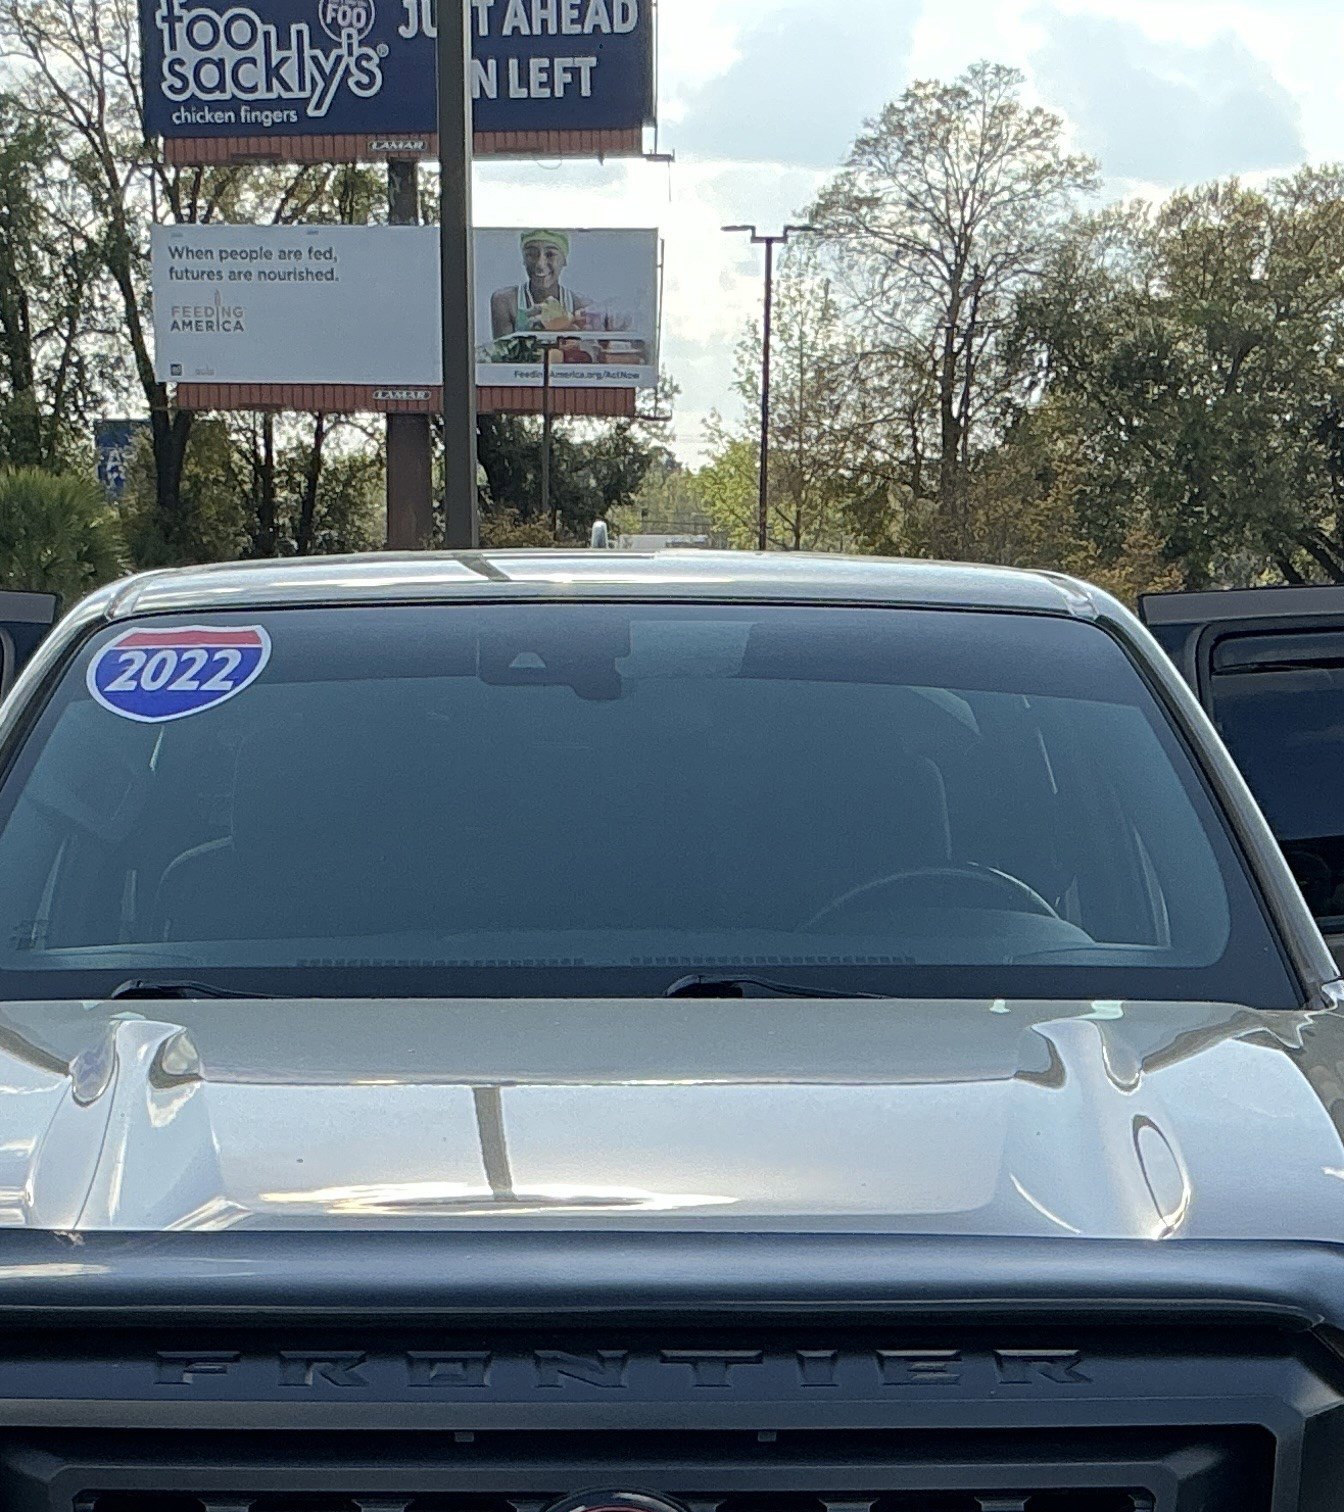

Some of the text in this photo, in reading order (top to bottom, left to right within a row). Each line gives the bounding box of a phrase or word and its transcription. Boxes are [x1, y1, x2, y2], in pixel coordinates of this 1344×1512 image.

[326, 4, 367, 29] FOO
[398, 0, 639, 38] JUT AHEAD
[509, 57, 597, 98] LEFT
[171, 105, 298, 127] chicken fingers
[168, 246, 338, 263] When people are fed,
[169, 266, 340, 282] futures are nourished.
[171, 305, 244, 319] FEEDING
[170, 319, 245, 333] AMERICA
[103, 648, 242, 692] 2022
[154, 1349, 1094, 1388] FRONTIER
